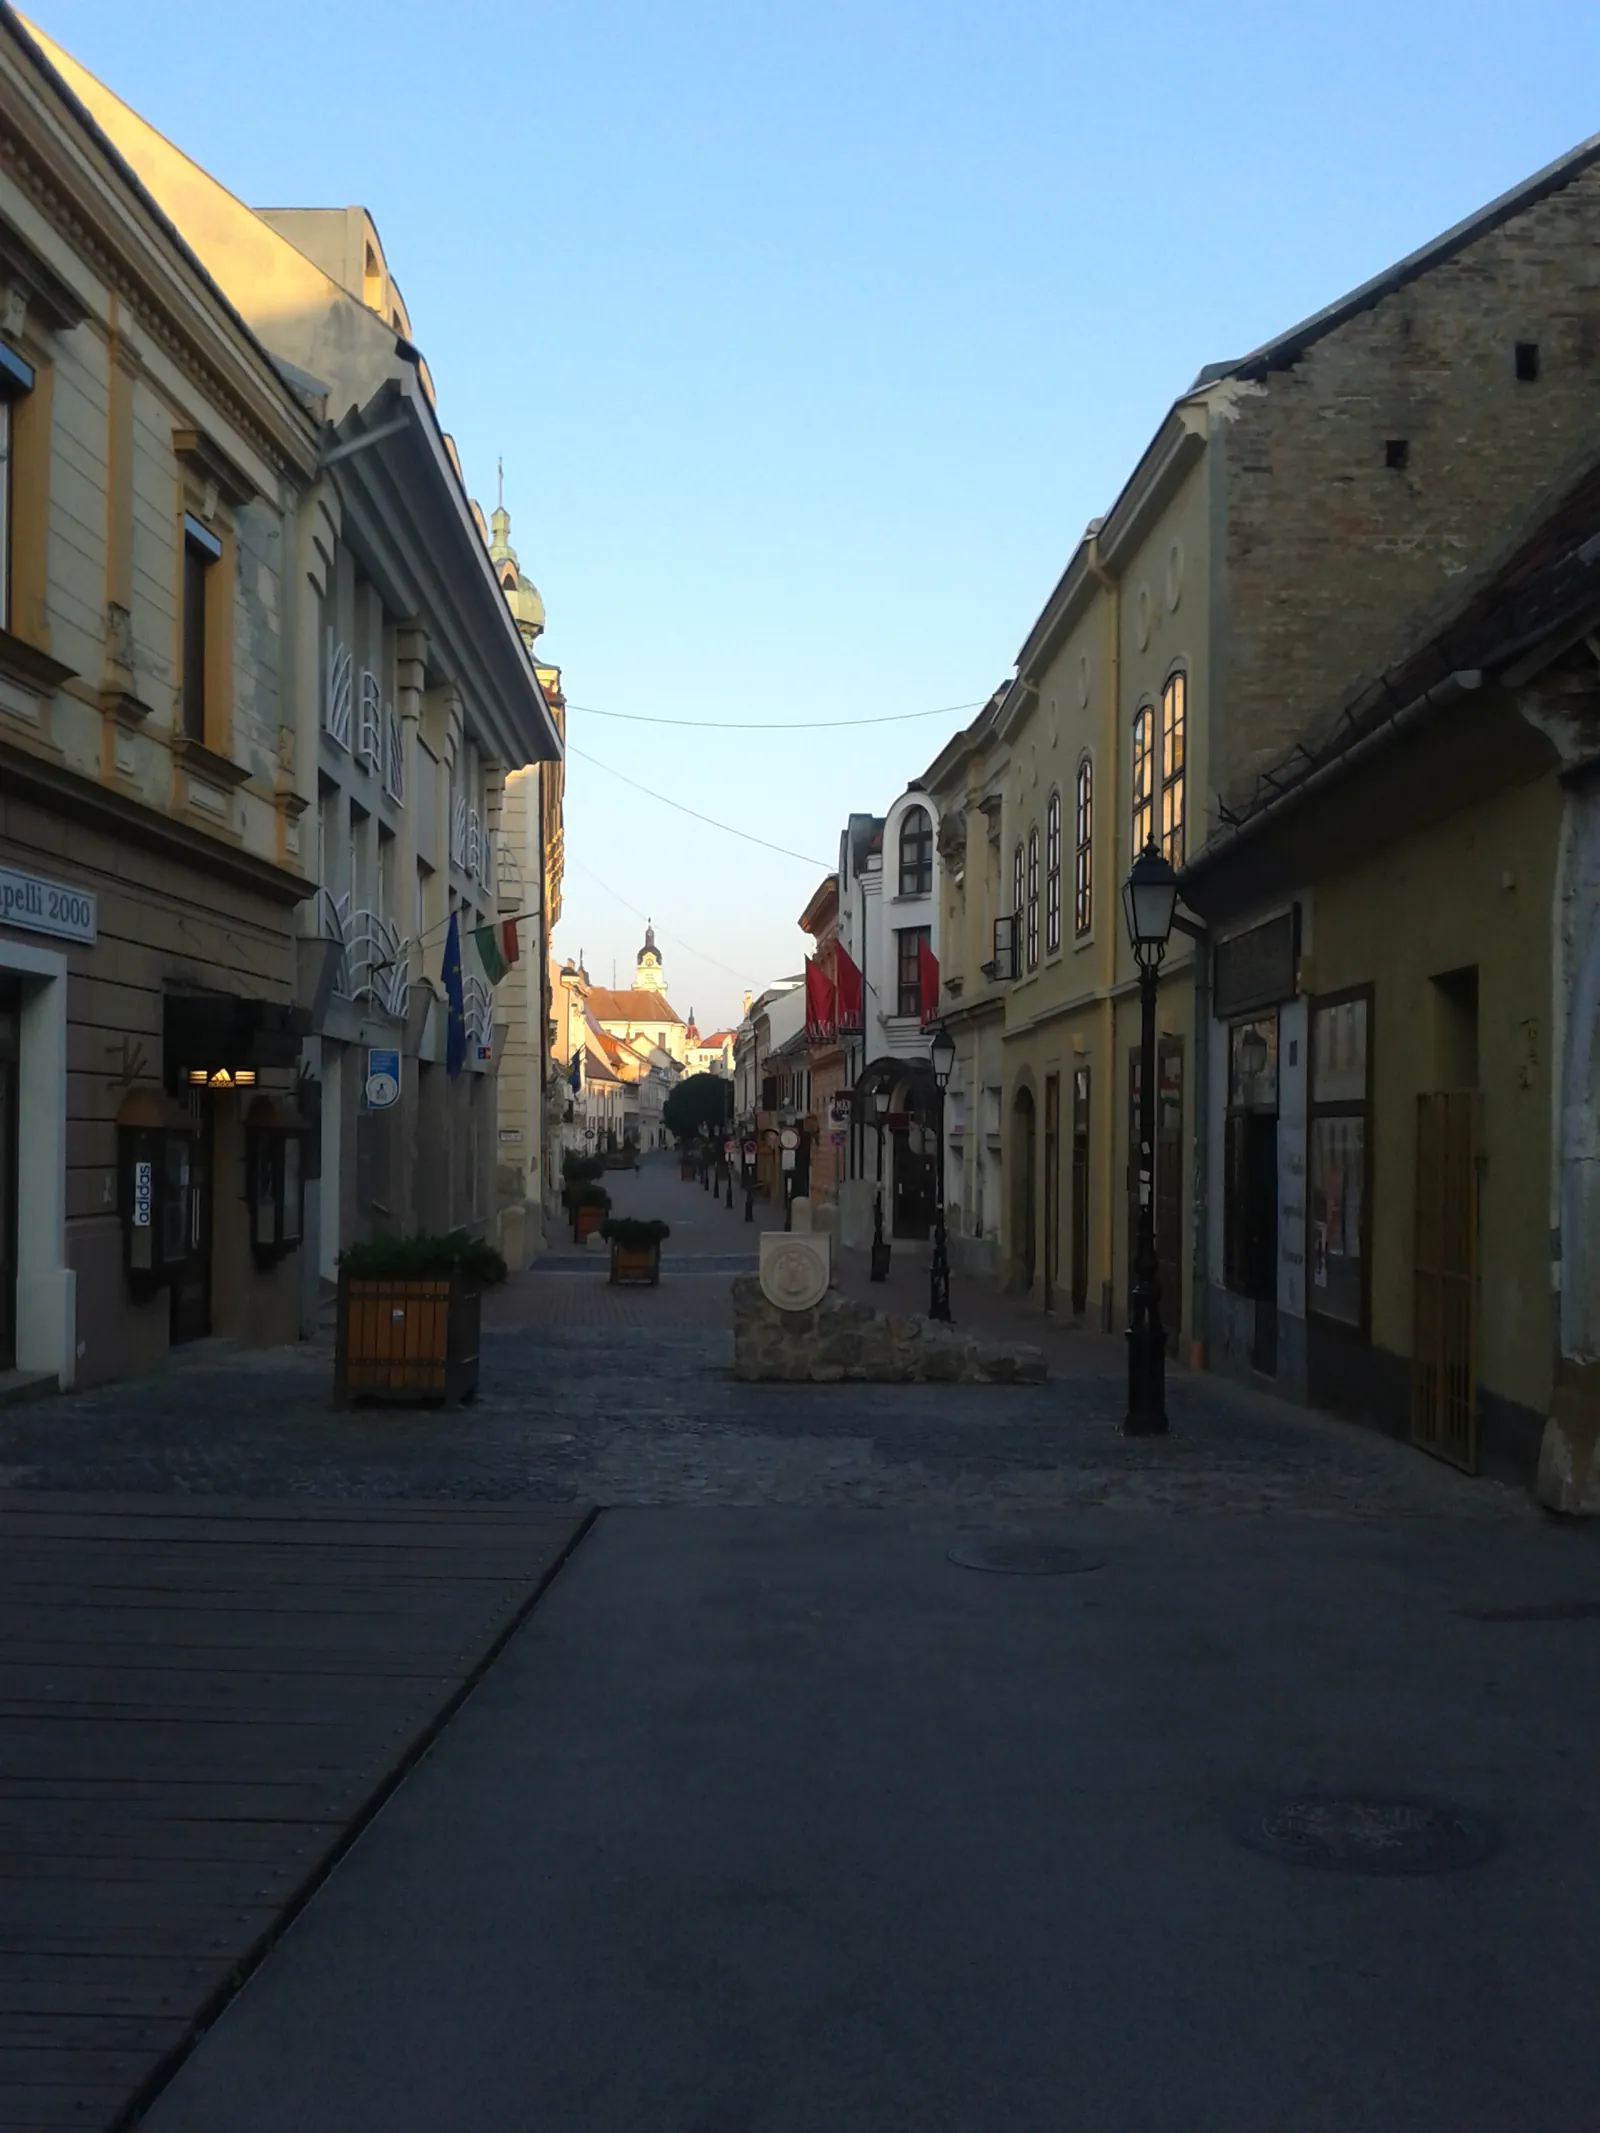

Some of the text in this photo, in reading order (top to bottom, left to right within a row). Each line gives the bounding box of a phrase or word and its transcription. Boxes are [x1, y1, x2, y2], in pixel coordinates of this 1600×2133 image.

[0, 882, 90, 928] pelli 2000
[207, 1080, 235, 1090] adidas
[136, 1165, 150, 1223] adidas
